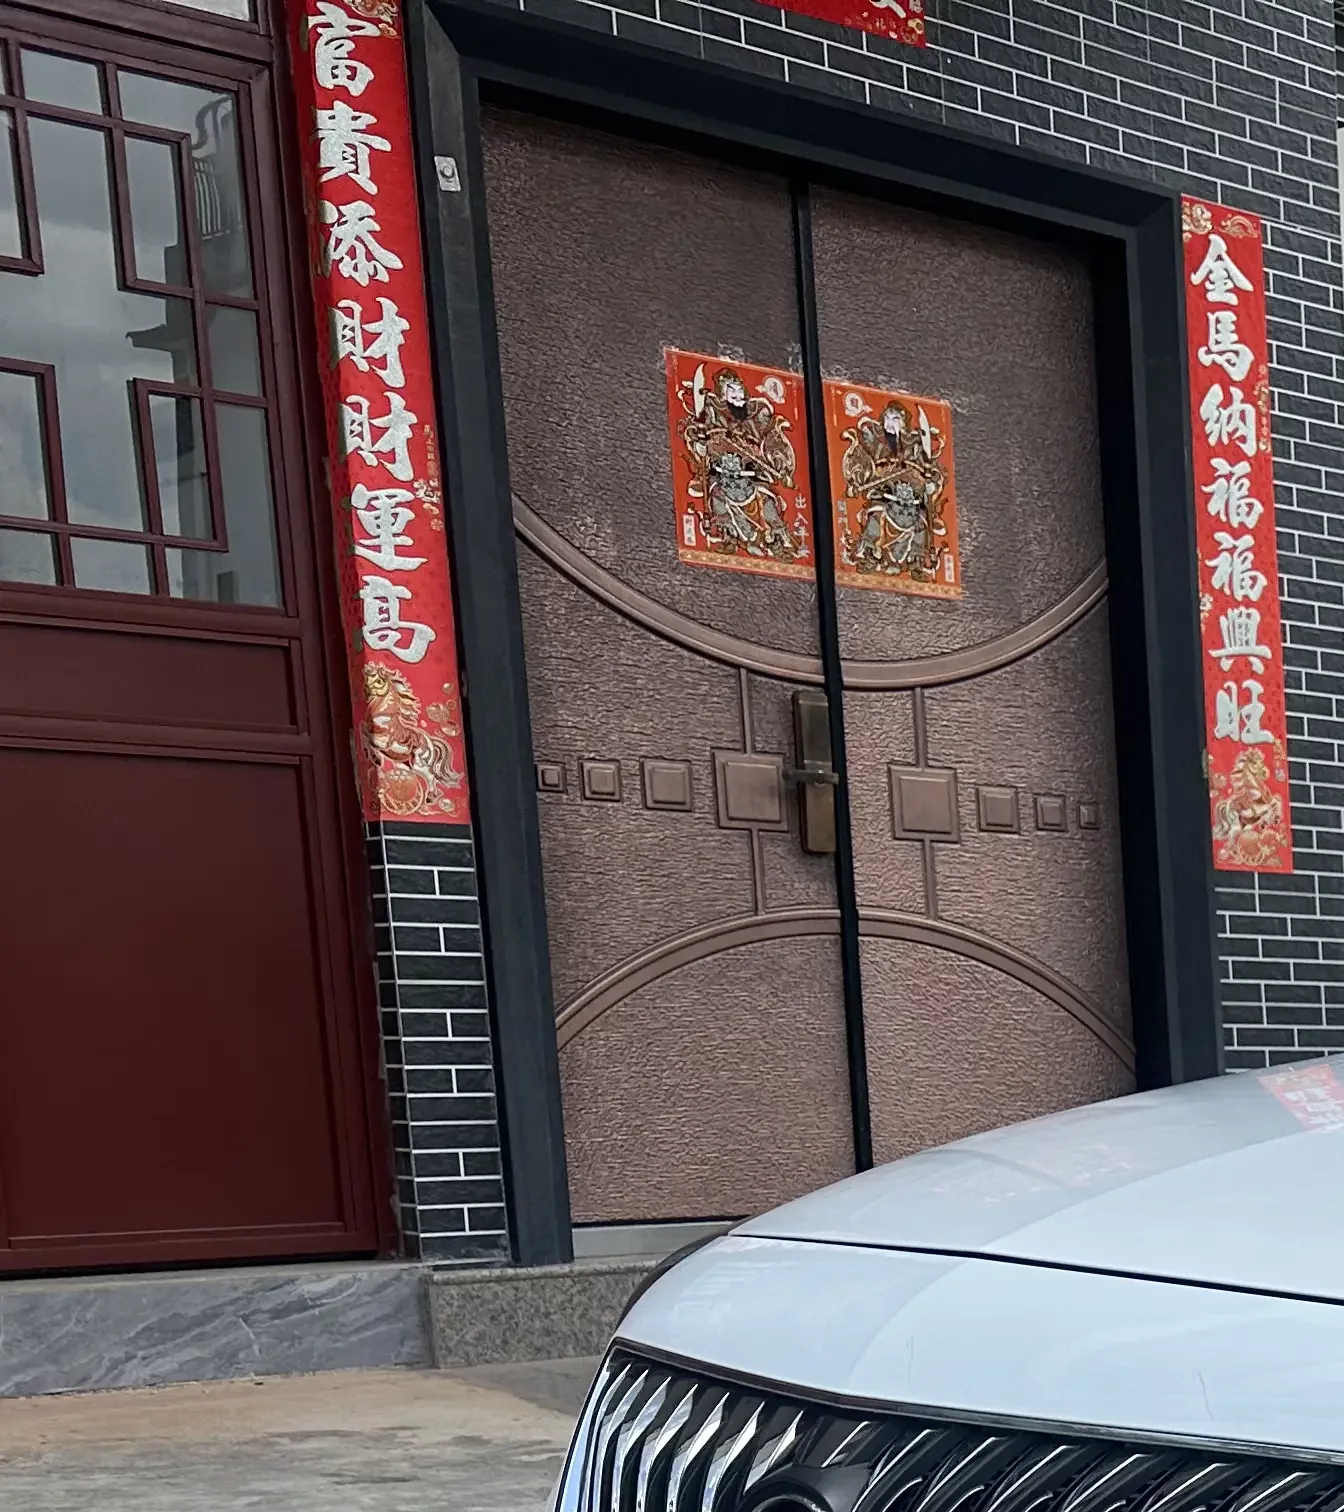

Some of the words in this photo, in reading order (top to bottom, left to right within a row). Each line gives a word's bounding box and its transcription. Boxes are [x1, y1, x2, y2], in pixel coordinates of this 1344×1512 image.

[1190, 233, 1275, 744] 金馬納福福興旺
